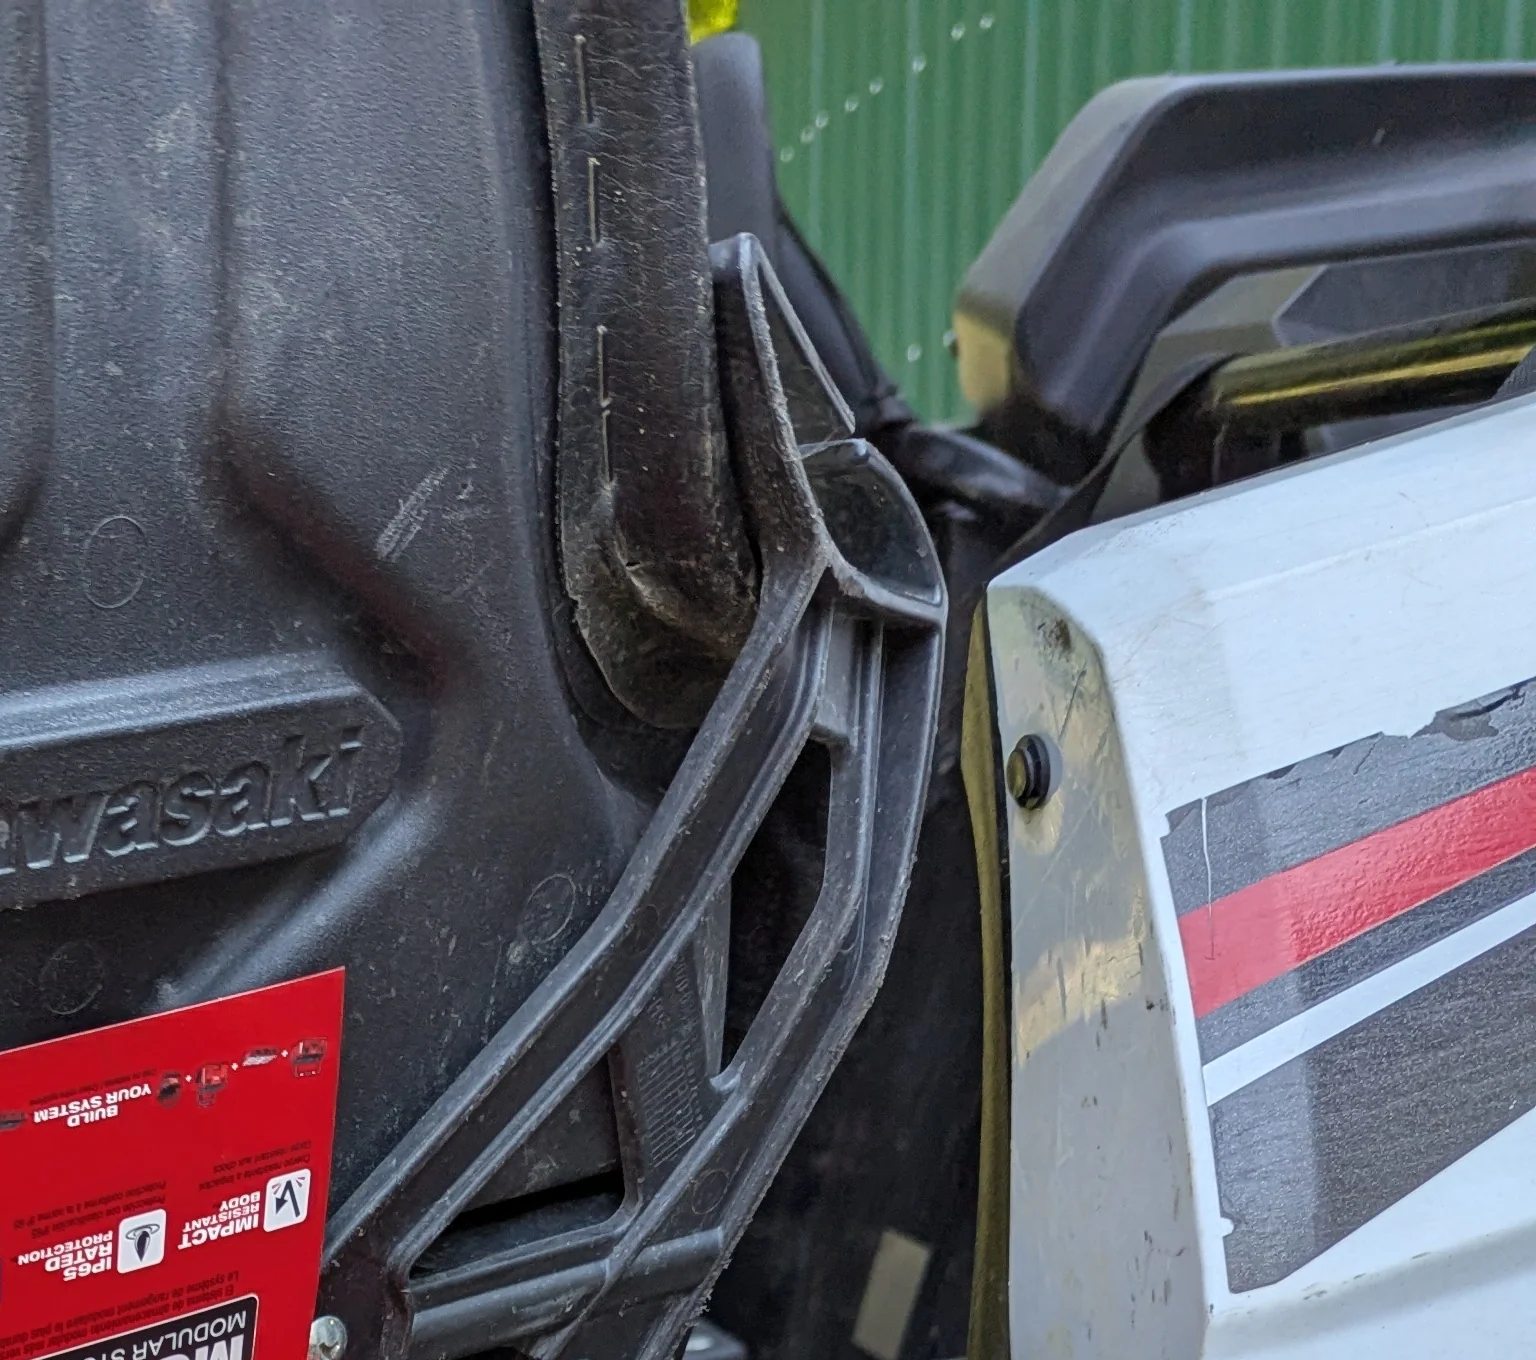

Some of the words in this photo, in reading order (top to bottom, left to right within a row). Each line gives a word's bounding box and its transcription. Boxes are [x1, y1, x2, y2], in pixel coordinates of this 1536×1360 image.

[33, 1094, 102, 1123] SYSTEM
[105, 1082, 152, 1106] YOUR
[66, 1104, 118, 1128] BUILD
[220, 1190, 260, 1210] BODY
[182, 1202, 260, 1232] RESISTANT
[178, 1214, 259, 1250] IMPACT
[17, 1230, 113, 1265] PROTECTION
[44, 1241, 113, 1272] RATED
[62, 1256, 112, 1282] IP65
[132, 1310, 246, 1360] MODULAR
